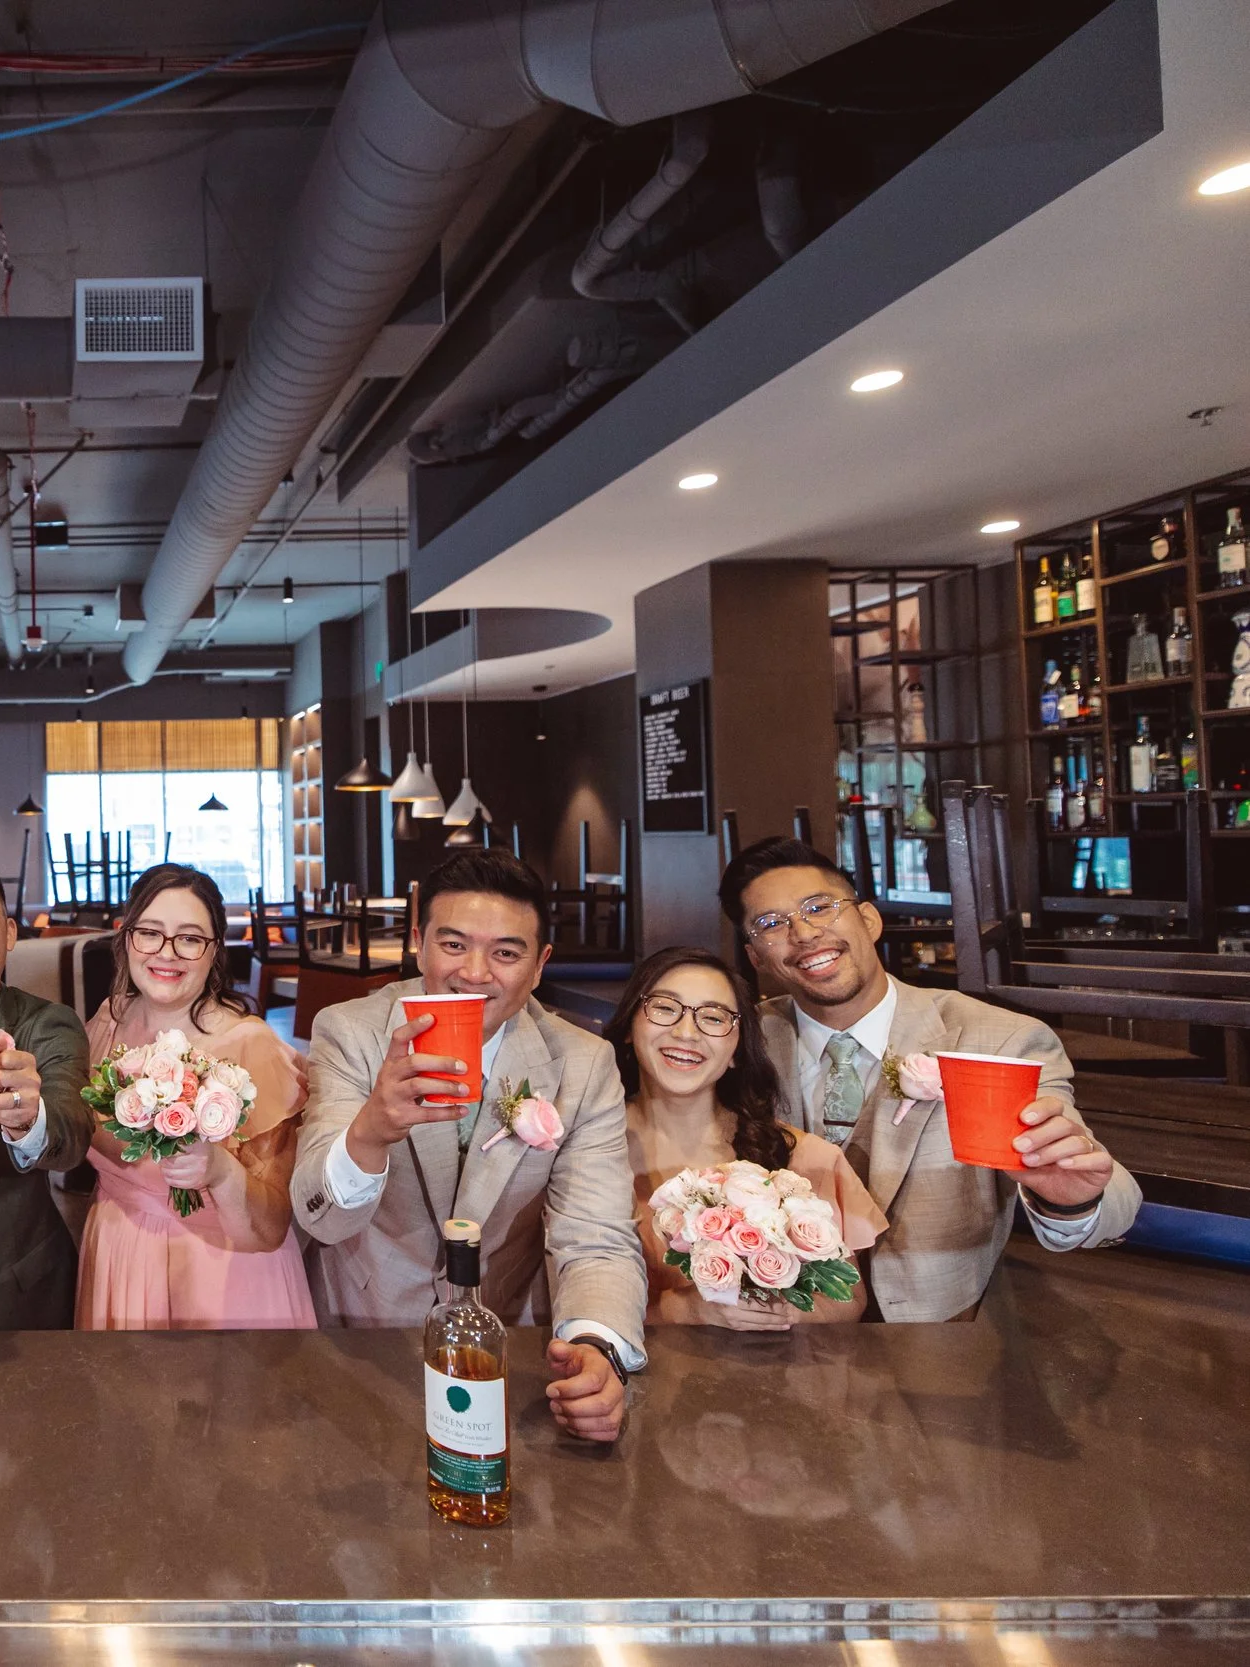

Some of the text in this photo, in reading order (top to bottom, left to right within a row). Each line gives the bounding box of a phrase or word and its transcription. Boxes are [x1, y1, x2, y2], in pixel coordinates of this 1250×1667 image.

[671, 686, 689, 701] BEER
[433, 1410, 463, 1429] GREEN
[467, 1422, 492, 1432] SPOT
